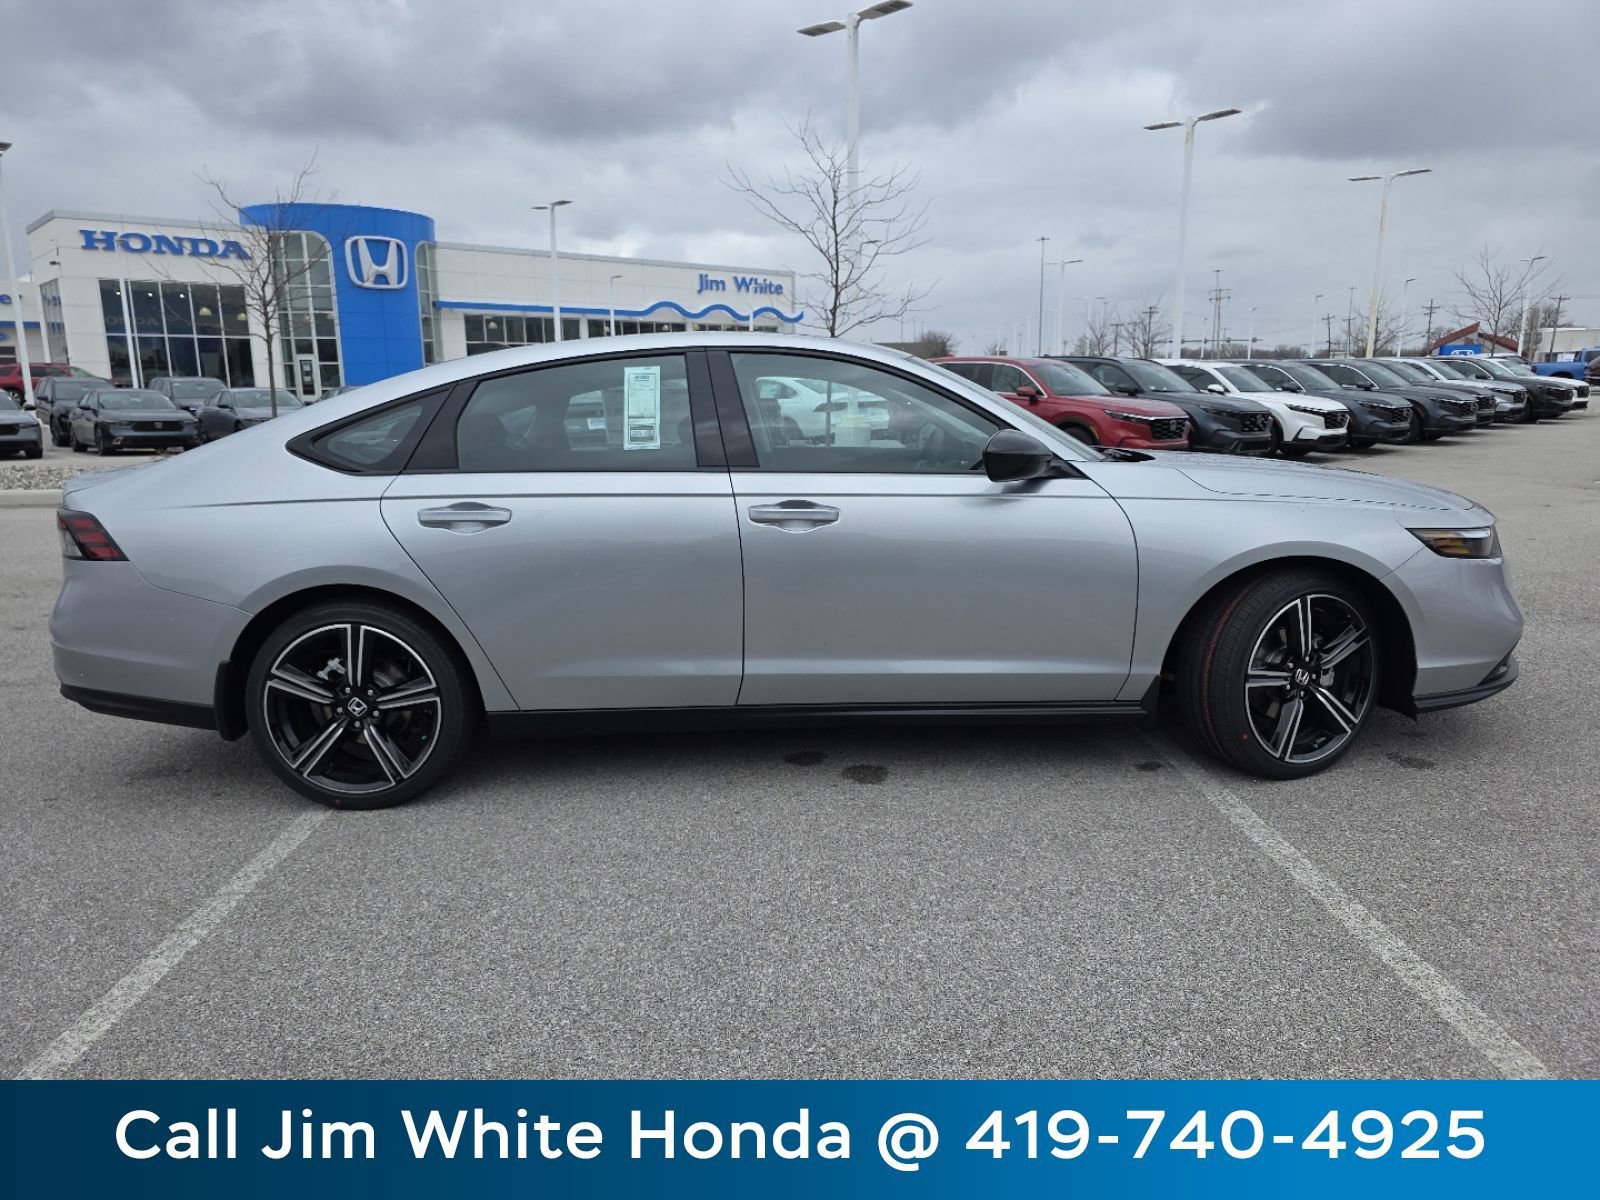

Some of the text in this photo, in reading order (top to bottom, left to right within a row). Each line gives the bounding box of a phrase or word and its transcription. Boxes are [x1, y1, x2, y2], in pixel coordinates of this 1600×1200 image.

[79, 229, 252, 260] HONDA
[697, 273, 784, 295] Jim White
